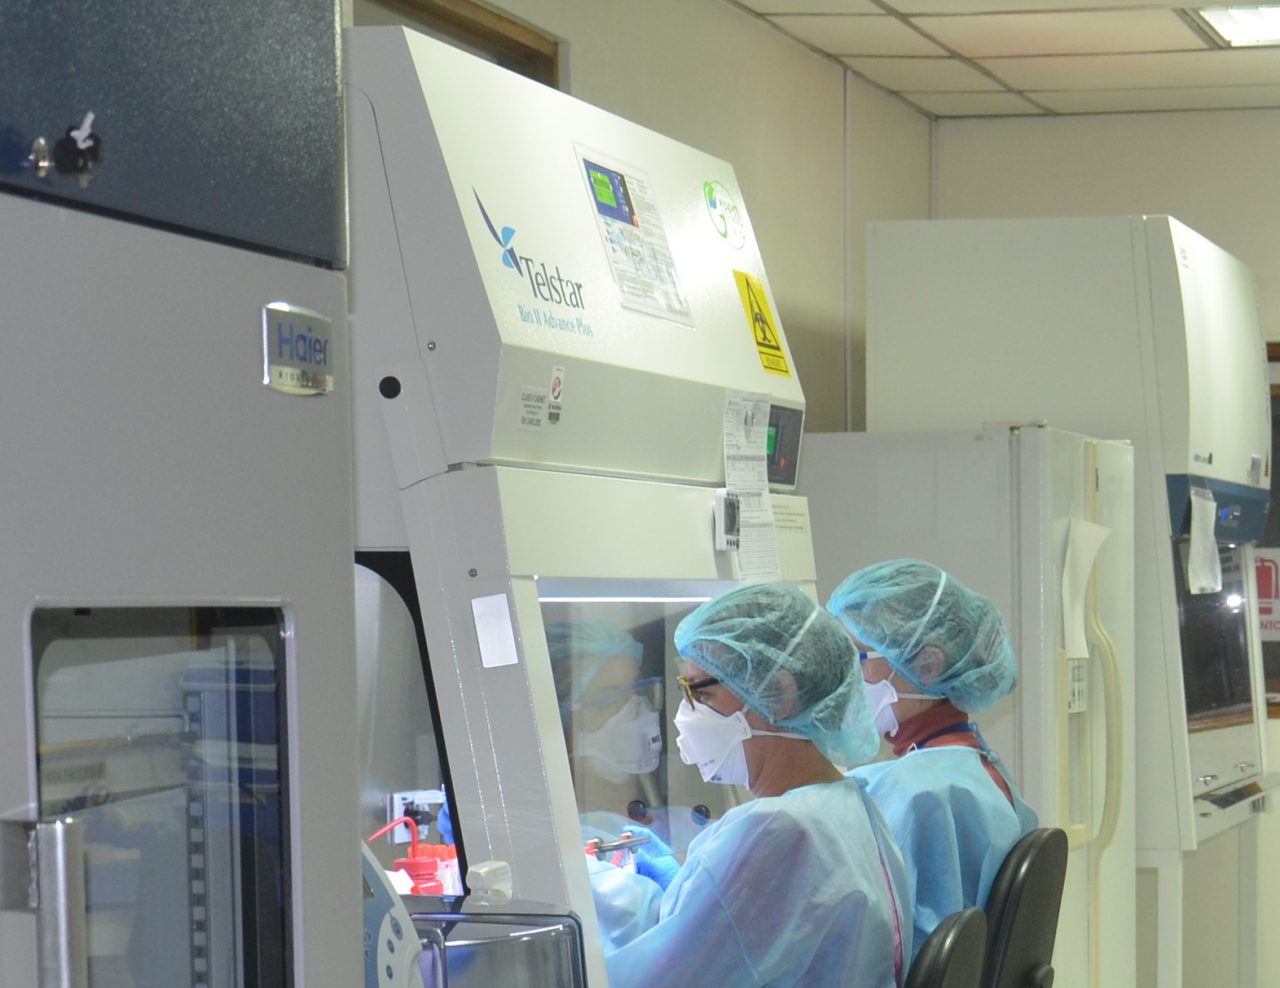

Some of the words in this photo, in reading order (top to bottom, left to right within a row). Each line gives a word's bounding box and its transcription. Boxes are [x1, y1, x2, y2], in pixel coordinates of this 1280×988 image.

[519, 255, 585, 310] Telstar
[518, 303, 534, 324] Bio
[543, 310, 576, 333] Advance
[575, 316, 594, 337] Plus
[276, 321, 329, 366] Haier
